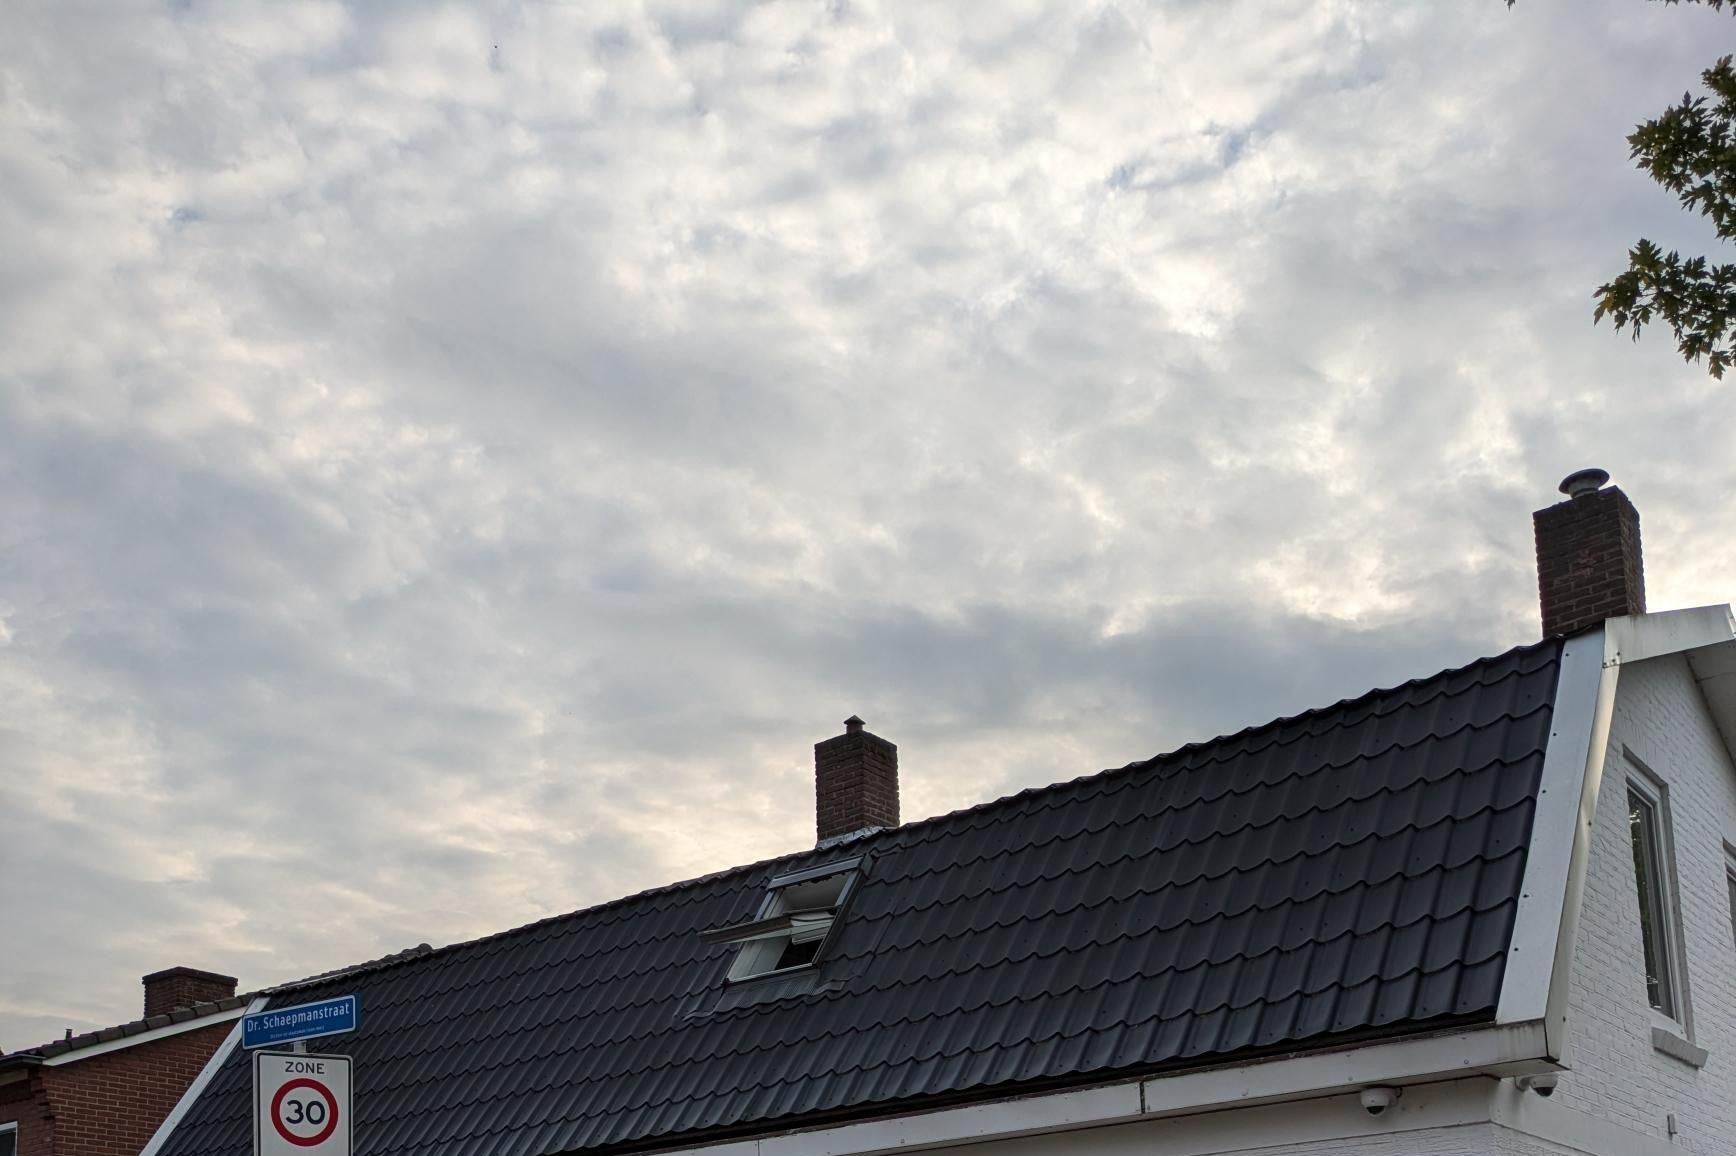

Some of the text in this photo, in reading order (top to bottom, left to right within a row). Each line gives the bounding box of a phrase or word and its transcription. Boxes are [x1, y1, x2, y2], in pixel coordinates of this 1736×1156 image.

[247, 1020, 261, 1033] Dr.
[263, 1002, 350, 1029] Schaepmanstraat
[285, 1061, 325, 1074] ZONE
[285, 1100, 326, 1125] 30
